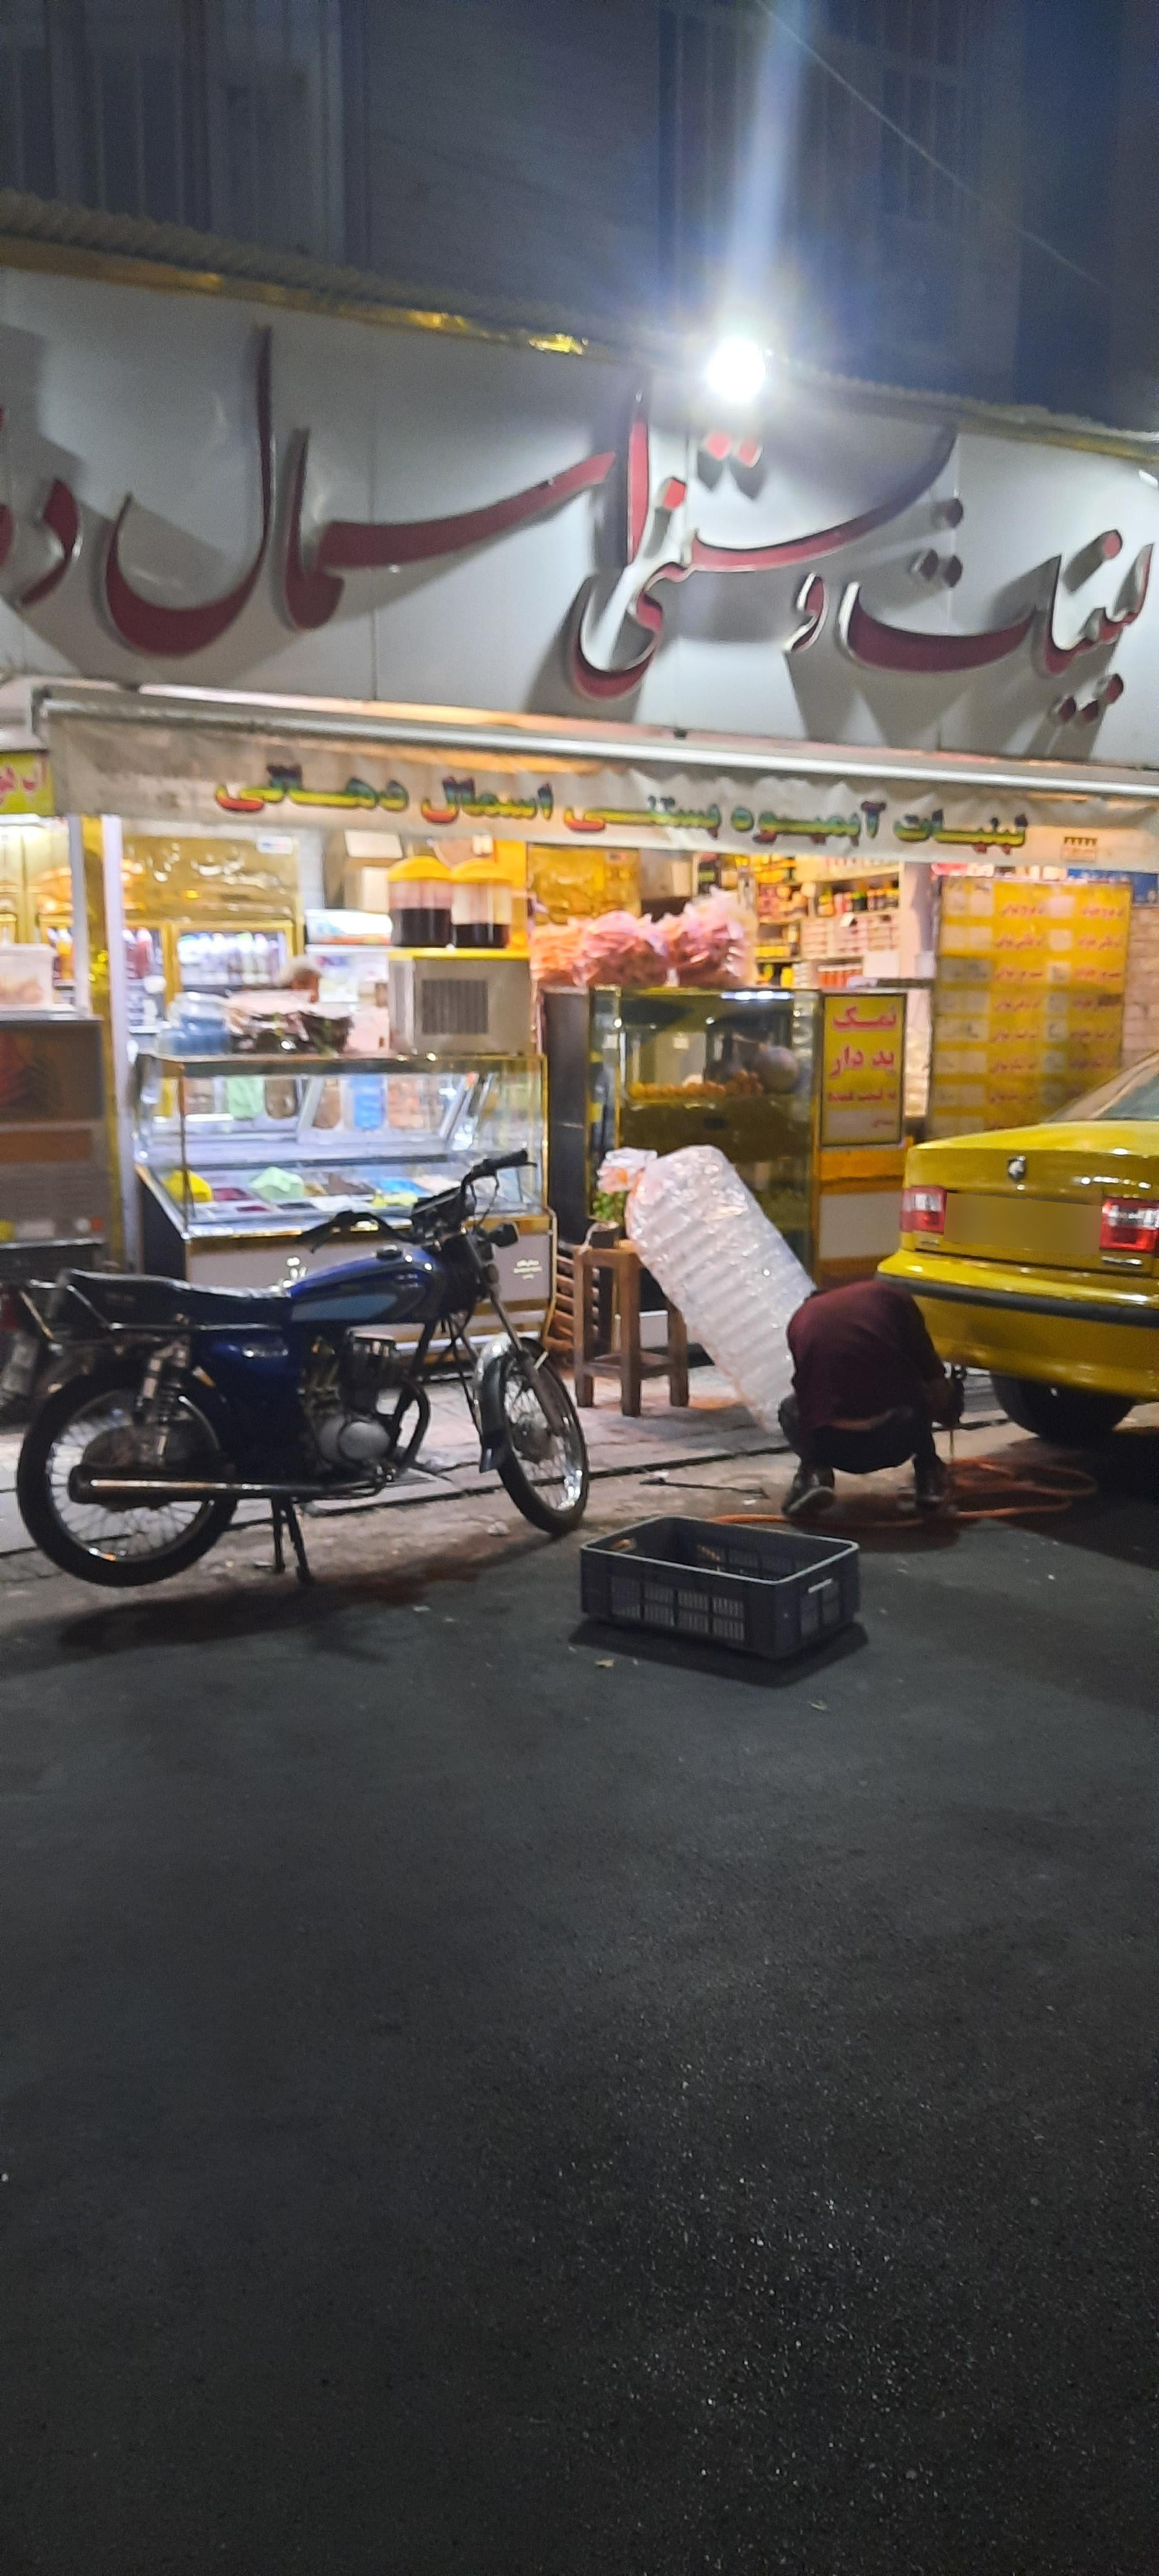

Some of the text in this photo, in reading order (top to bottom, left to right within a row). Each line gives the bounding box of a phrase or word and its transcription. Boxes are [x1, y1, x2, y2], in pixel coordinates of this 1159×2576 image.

[786, 571, 828, 656] و
[216, 764, 1028, 855] لبنیات آبمیوه بستنی اسمال دهاتی
[833, 1003, 898, 1030] نمک
